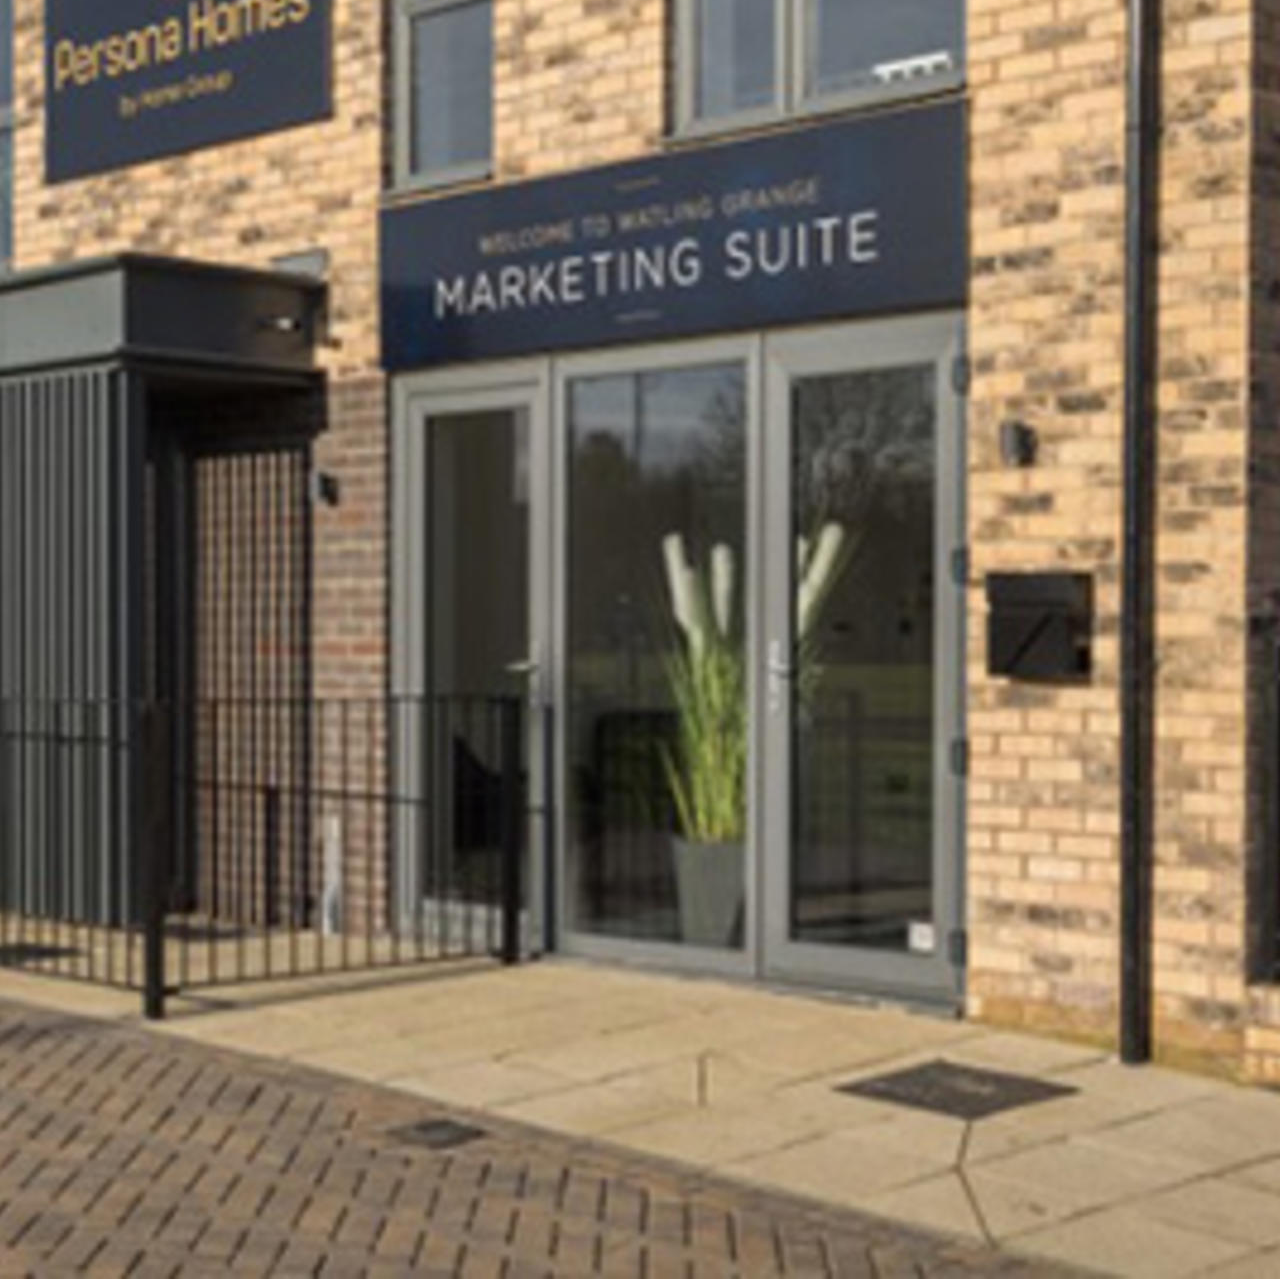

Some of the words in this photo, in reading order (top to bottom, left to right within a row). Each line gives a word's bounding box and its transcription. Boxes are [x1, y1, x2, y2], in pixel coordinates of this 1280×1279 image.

[54, 18, 182, 91] Persona
[479, 219, 574, 255] WELCOME
[581, 213, 612, 239] TO
[721, 177, 819, 217] GRANGE
[434, 237, 702, 319] MARKETING
[724, 210, 878, 281] SUITE
